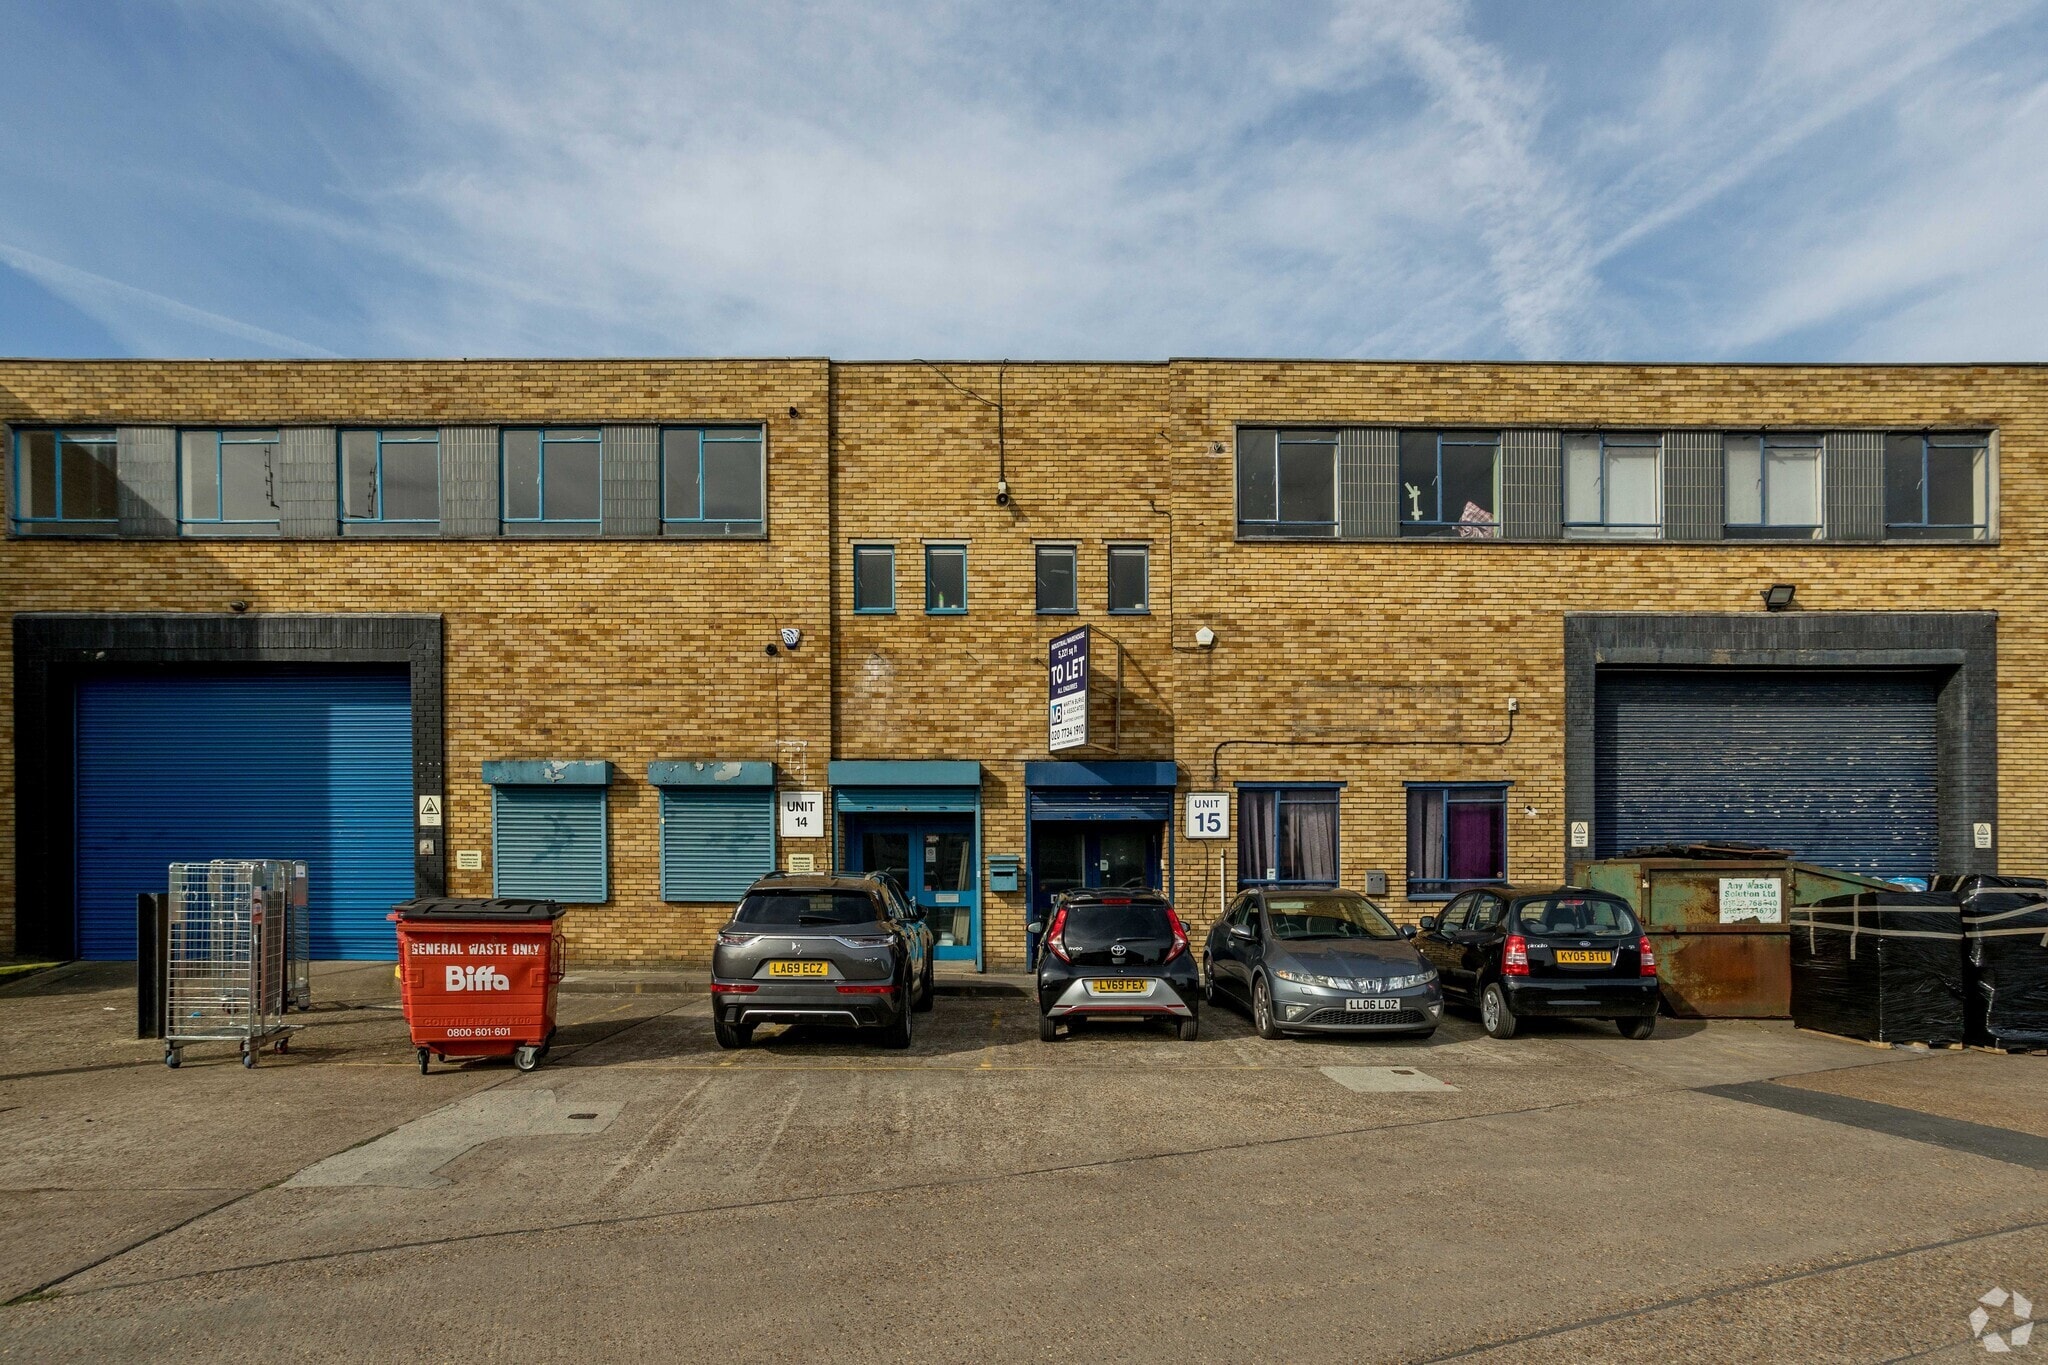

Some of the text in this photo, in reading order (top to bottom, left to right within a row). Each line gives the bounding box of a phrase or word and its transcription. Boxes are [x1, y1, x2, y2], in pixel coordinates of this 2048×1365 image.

[1051, 656, 1085, 686] TO LET
[787, 802, 815, 812] UNIT
[1194, 800, 1220, 808] UNIT
[795, 817, 808, 827] 14
[1195, 812, 1221, 832] 15
[1727, 882, 1743, 890] Any
[412, 943, 540, 955] GENERAL WASTE ONLY
[1561, 951, 1607, 961] KY05 BTU
[774, 963, 822, 973] LA69 ECZ
[445, 966, 510, 991] Biffa
[1100, 980, 1145, 989] LV69 FEX
[1350, 1000, 1397, 1009] LL06 LOZ
[424, 1017, 503, 1026] CONTINENTAL
